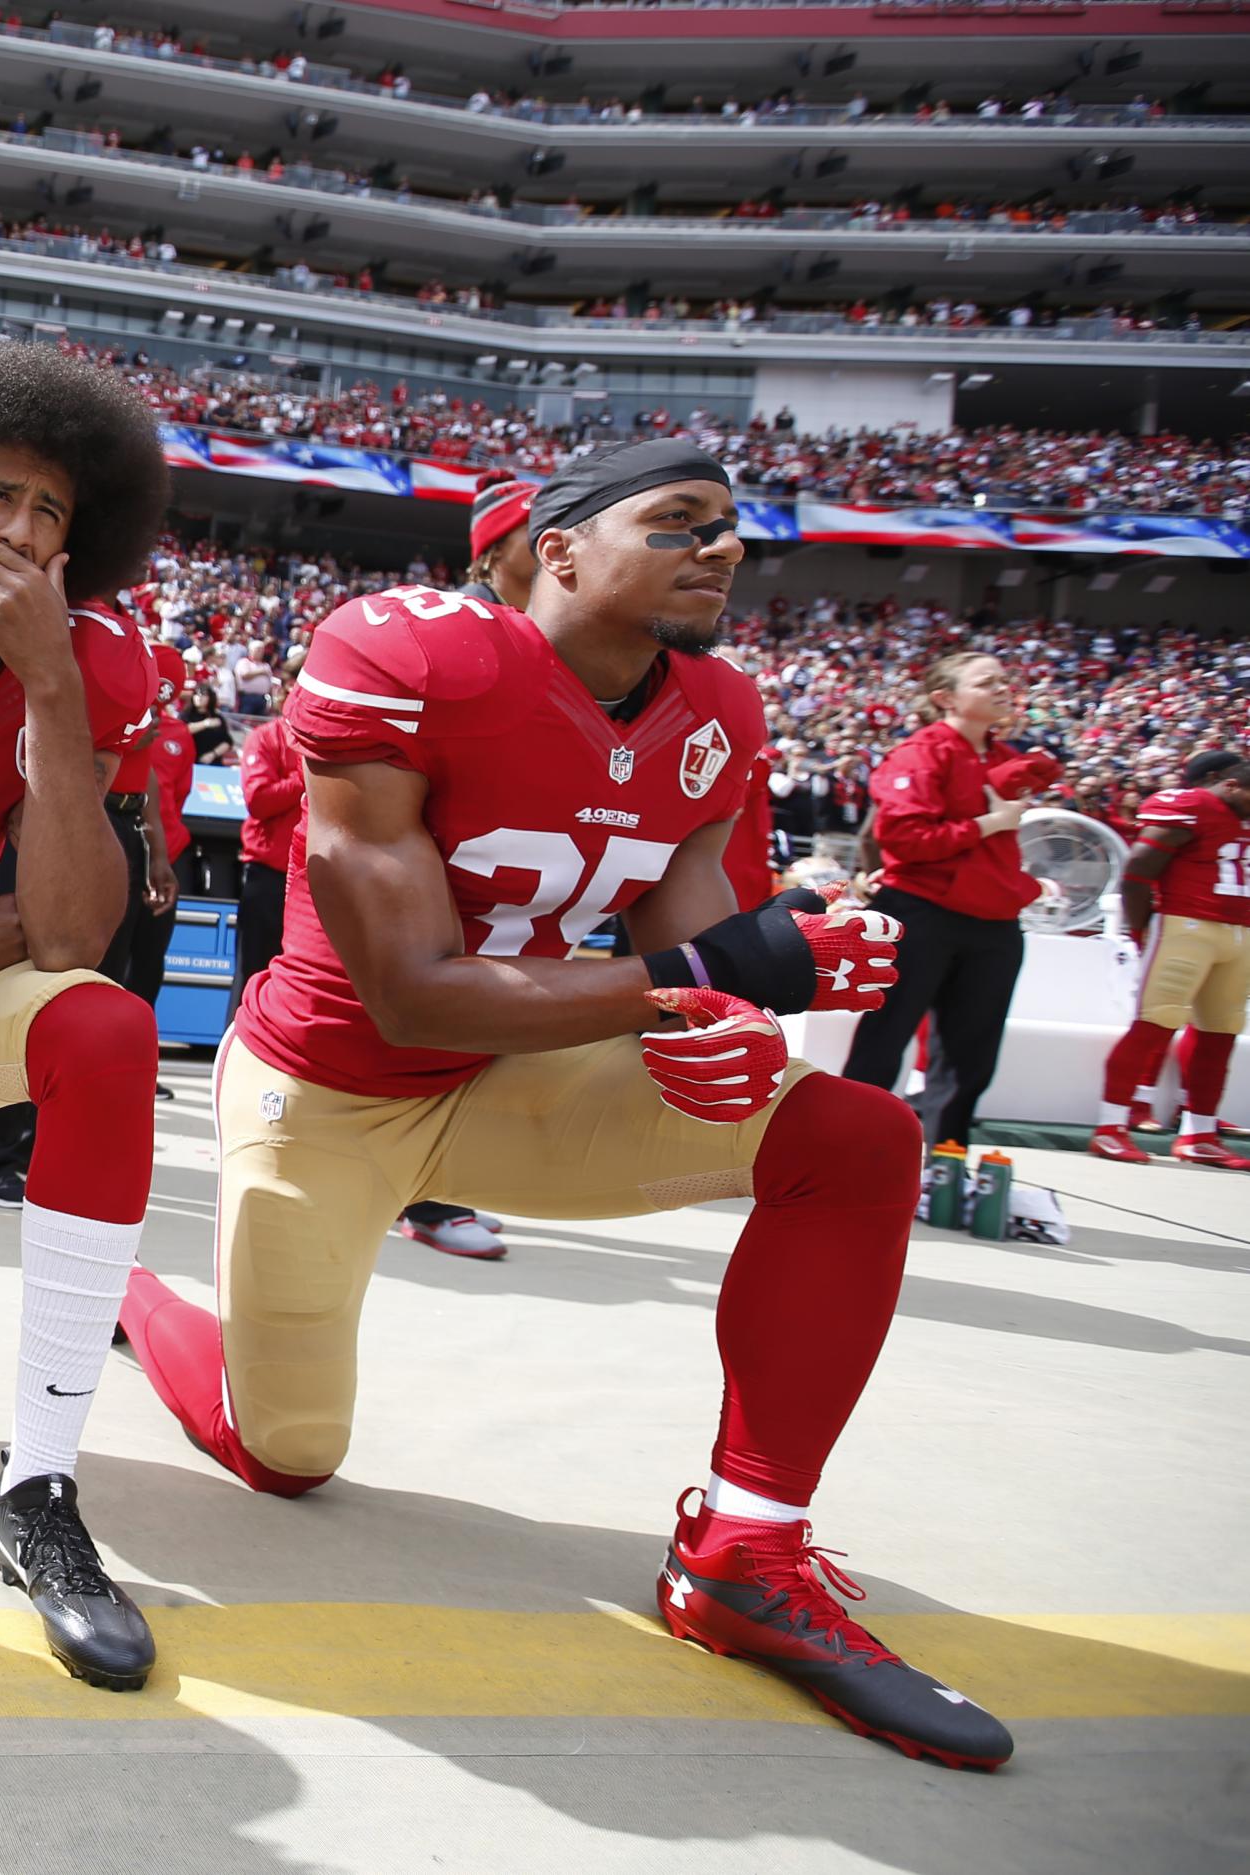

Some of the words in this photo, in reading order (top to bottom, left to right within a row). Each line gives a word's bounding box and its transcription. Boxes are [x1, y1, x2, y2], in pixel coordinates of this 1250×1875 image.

[613, 762, 629, 776] NFL
[688, 748, 720, 775] 70
[574, 807, 641, 829] 49ERS
